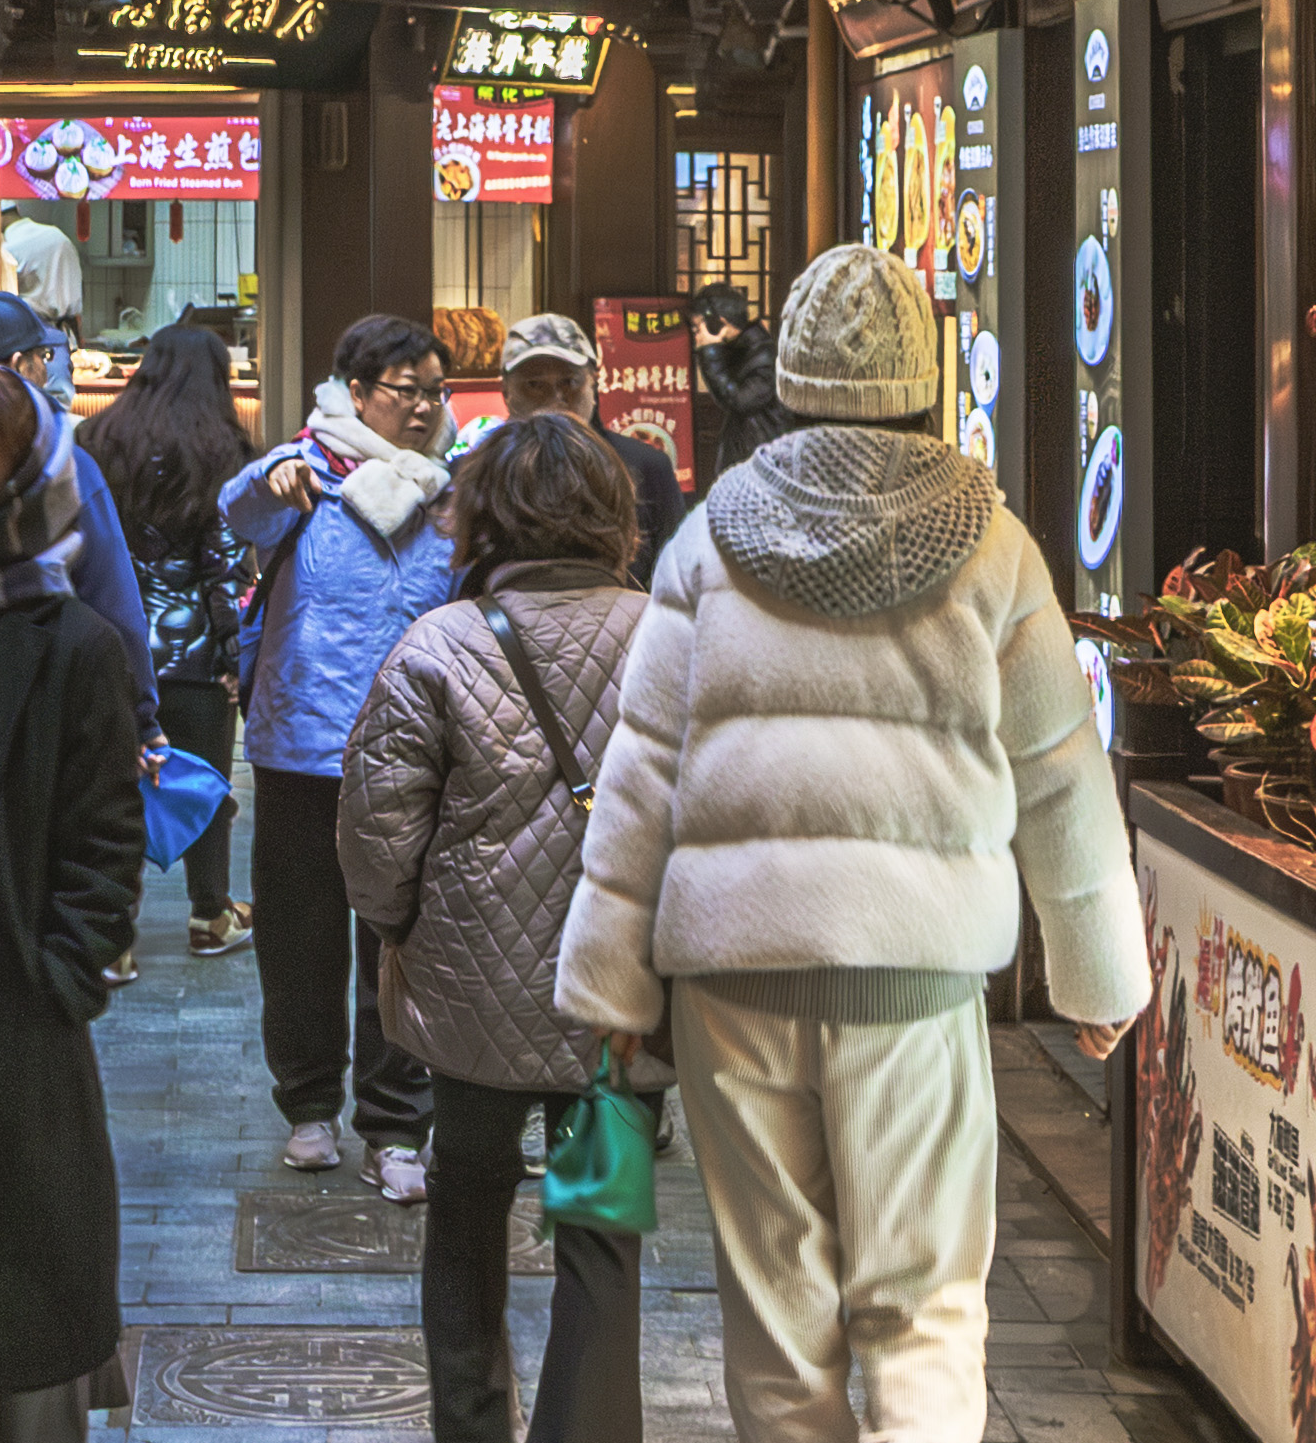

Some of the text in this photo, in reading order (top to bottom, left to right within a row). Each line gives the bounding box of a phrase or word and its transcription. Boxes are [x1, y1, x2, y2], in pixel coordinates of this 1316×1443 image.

[453, 28, 590, 80] 排骨年糕
[111, 130, 260, 172] 上海生煎包
[154, 176, 178, 188] Fried
[180, 176, 222, 189] Steamed
